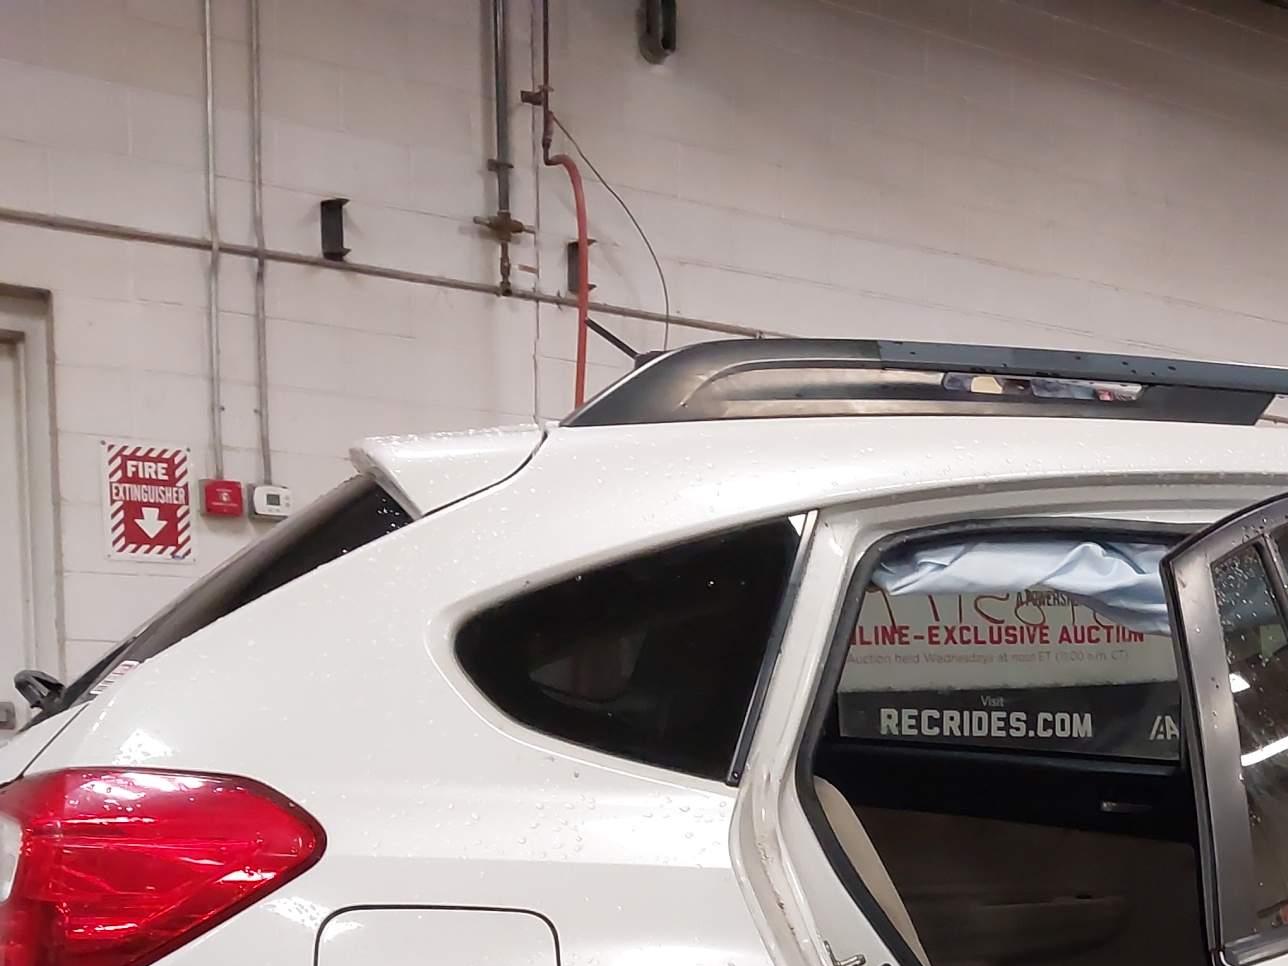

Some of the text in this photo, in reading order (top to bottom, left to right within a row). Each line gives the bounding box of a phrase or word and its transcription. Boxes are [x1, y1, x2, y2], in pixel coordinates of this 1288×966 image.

[127, 461, 168, 480] FIRE
[112, 484, 186, 504] EXTINGUISHER
[980, 696, 1004, 707] Visit
[880, 708, 1093, 738] RECRIDES.COM
